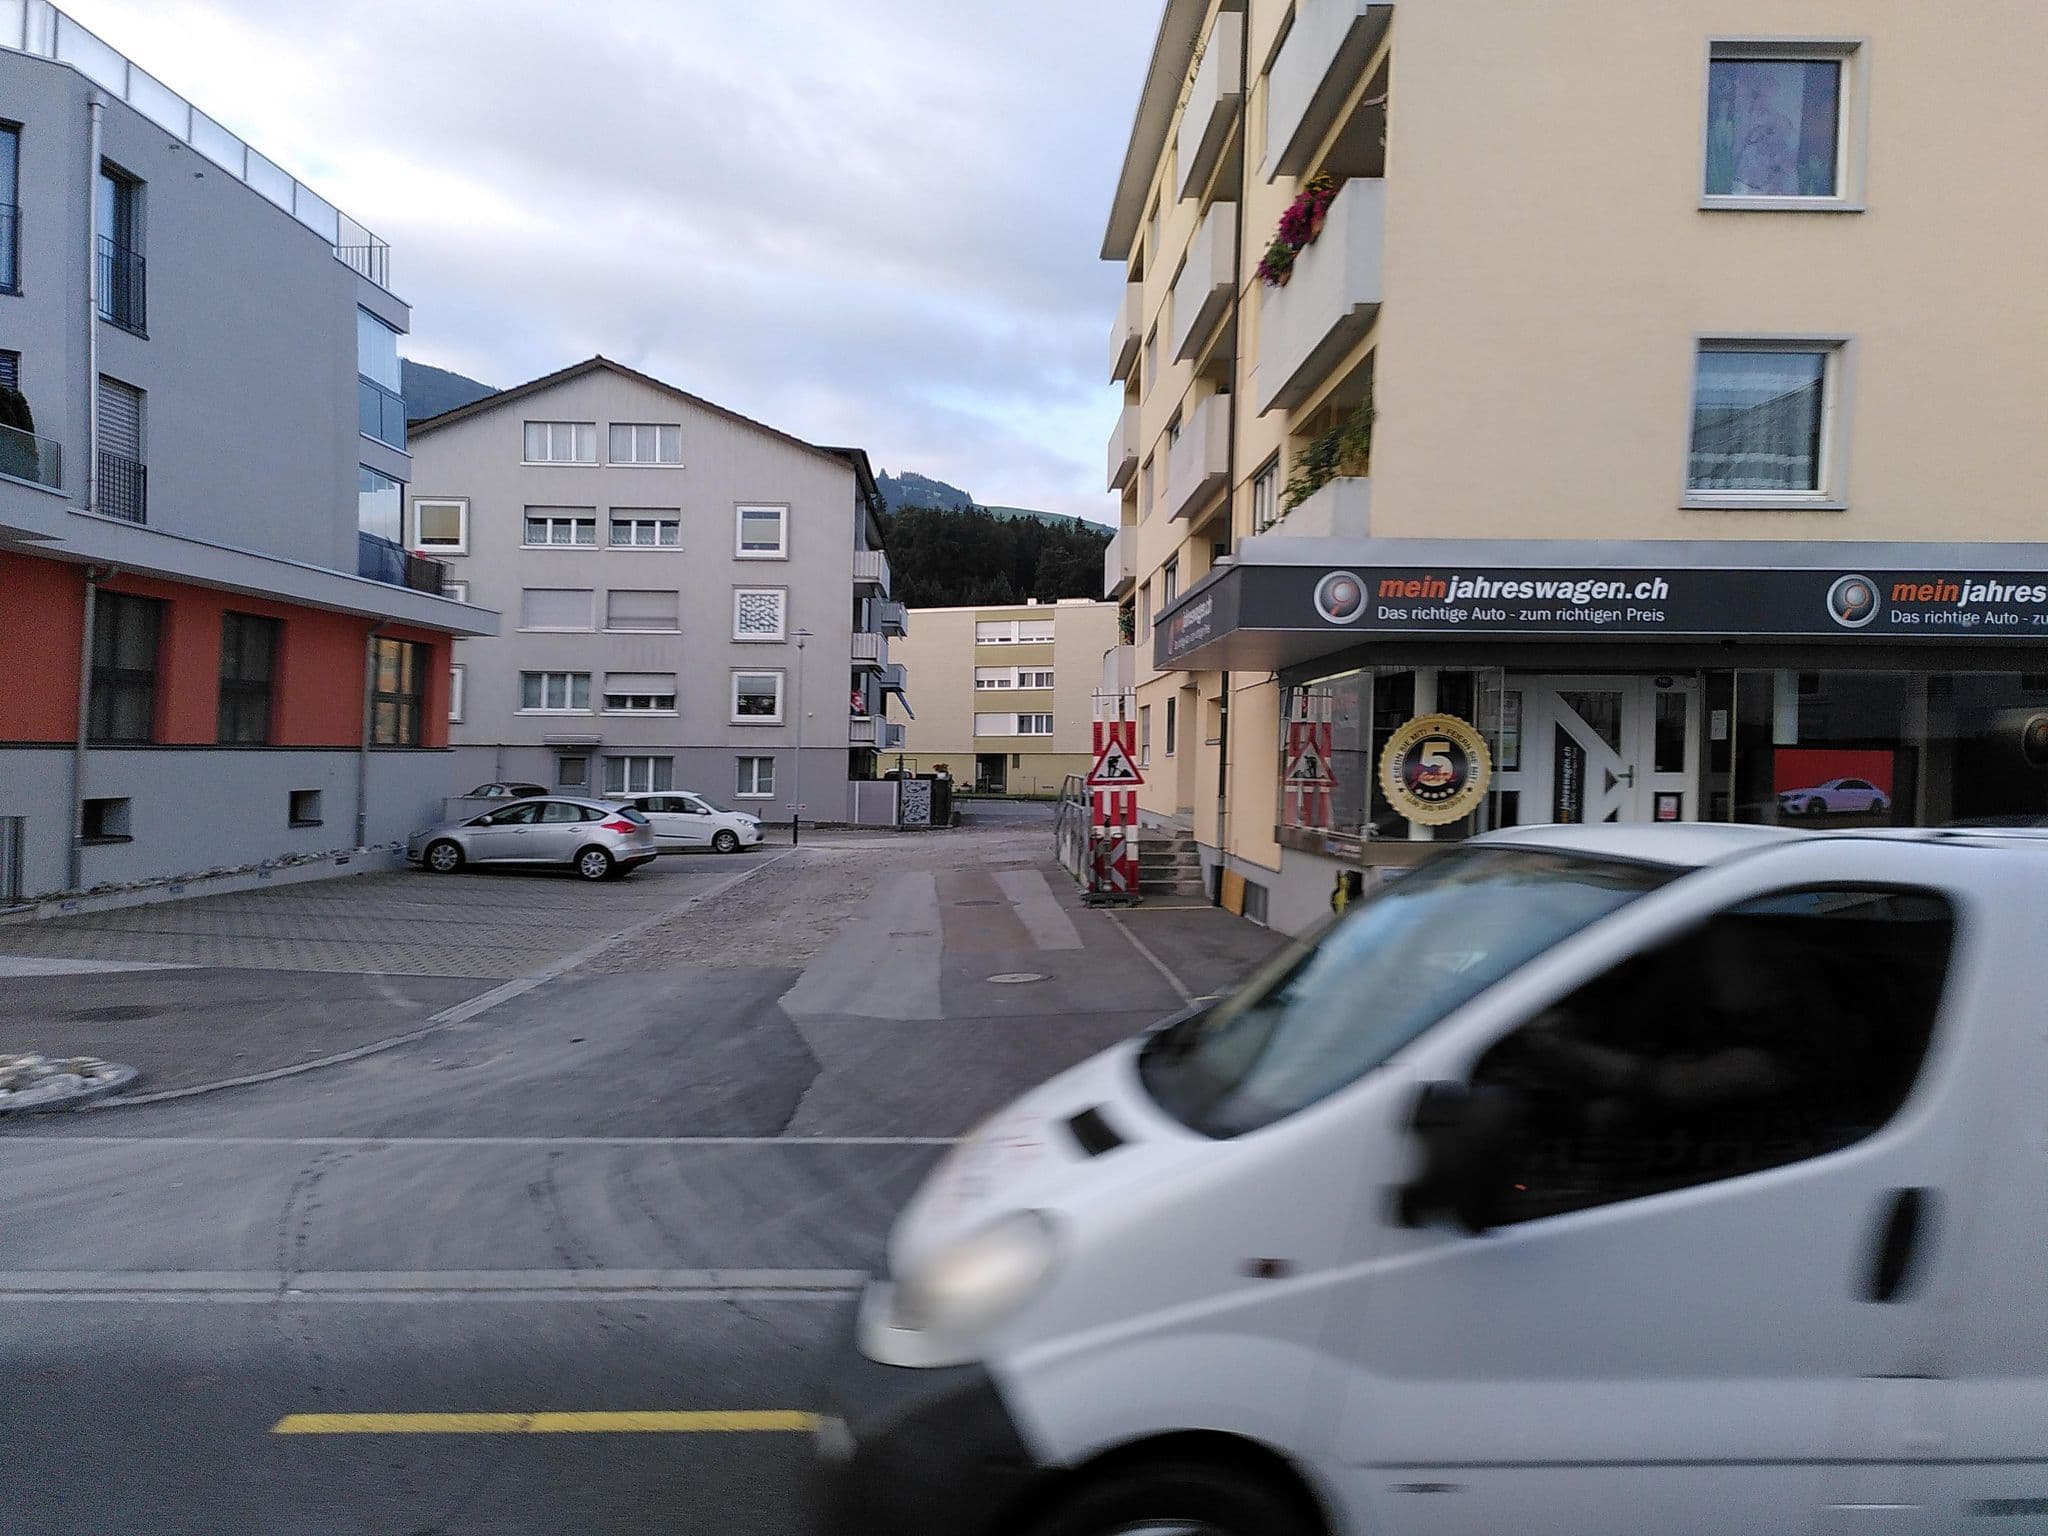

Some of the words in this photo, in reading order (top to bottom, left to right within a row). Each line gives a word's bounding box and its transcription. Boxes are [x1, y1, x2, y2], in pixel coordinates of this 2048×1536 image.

[1378, 575, 1669, 604] meinjahreswagen.ch
[1378, 606, 1407, 620] Das
[1411, 606, 1468, 622] richtige
[1471, 606, 1506, 621] Auto
[1519, 609, 1551, 621] zum
[1556, 607, 1622, 624] richtigen
[1627, 607, 1665, 622] Preis
[1891, 610, 1920, 624] Das
[1925, 610, 1980, 627] richtige
[1984, 610, 2018, 625] Auto
[1420, 741, 1454, 787] 5
